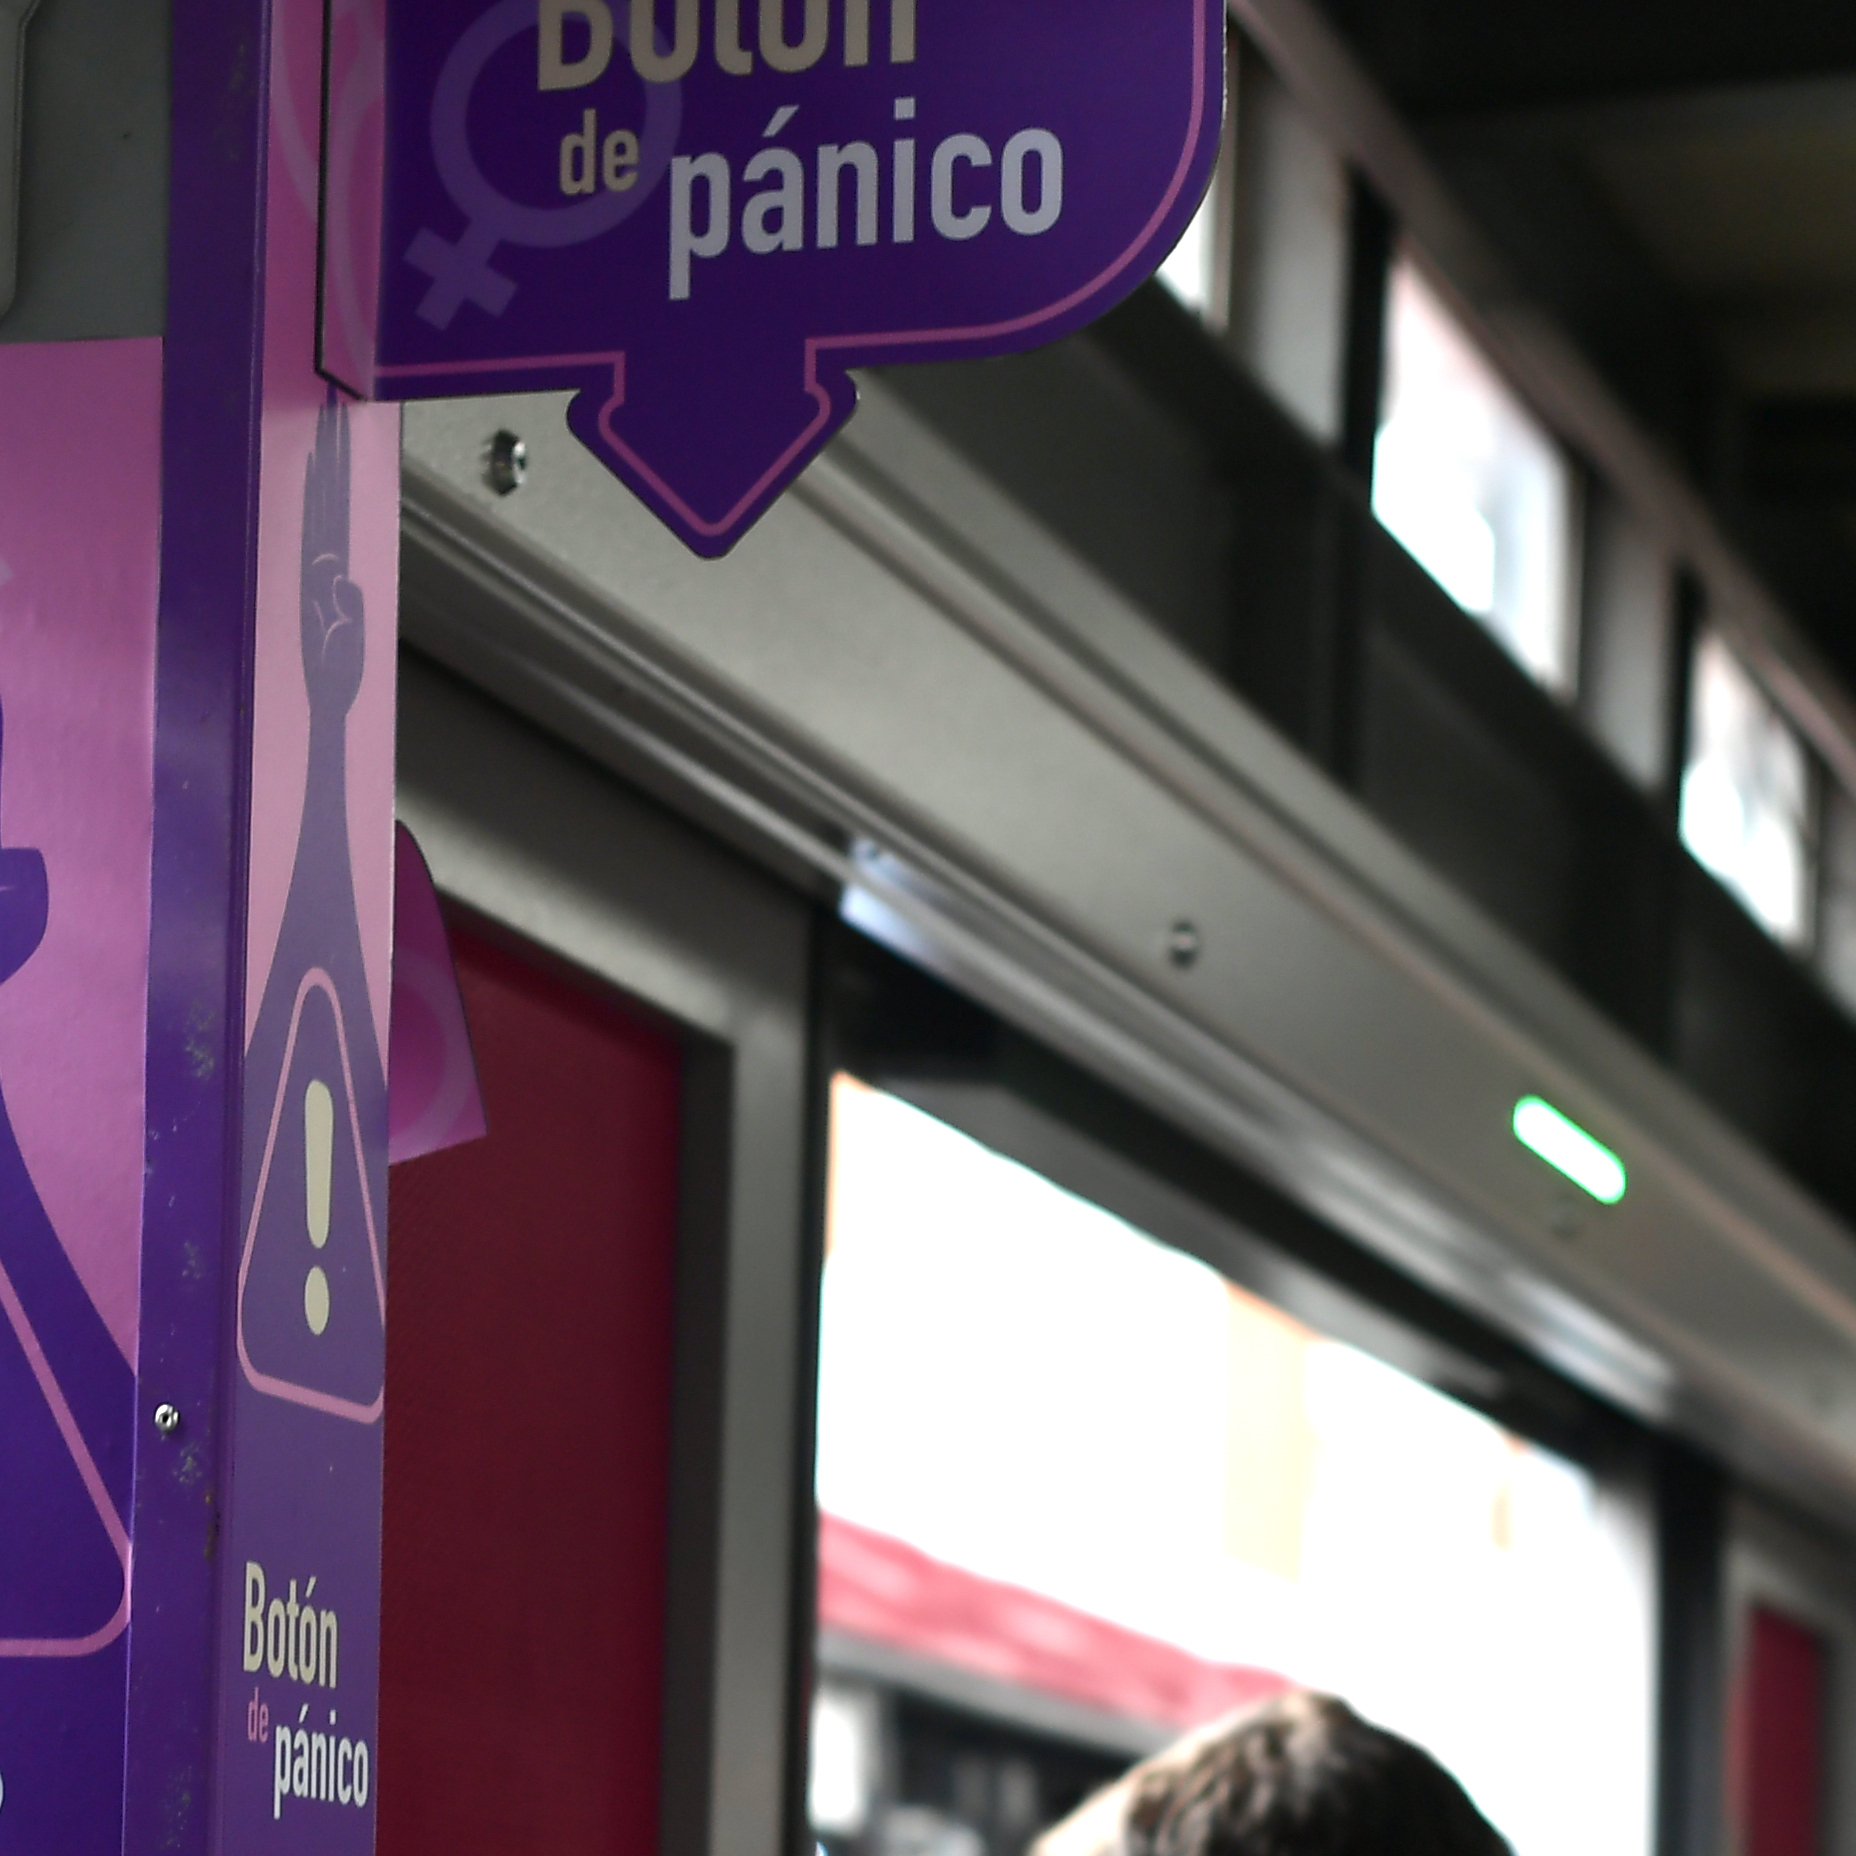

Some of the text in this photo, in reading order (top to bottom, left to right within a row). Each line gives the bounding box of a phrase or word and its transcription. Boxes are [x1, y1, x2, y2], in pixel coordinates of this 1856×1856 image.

[559, 96, 1063, 301] de pánico
[243, 1561, 338, 1689] Botón
[247, 1686, 369, 1820] de pánico
